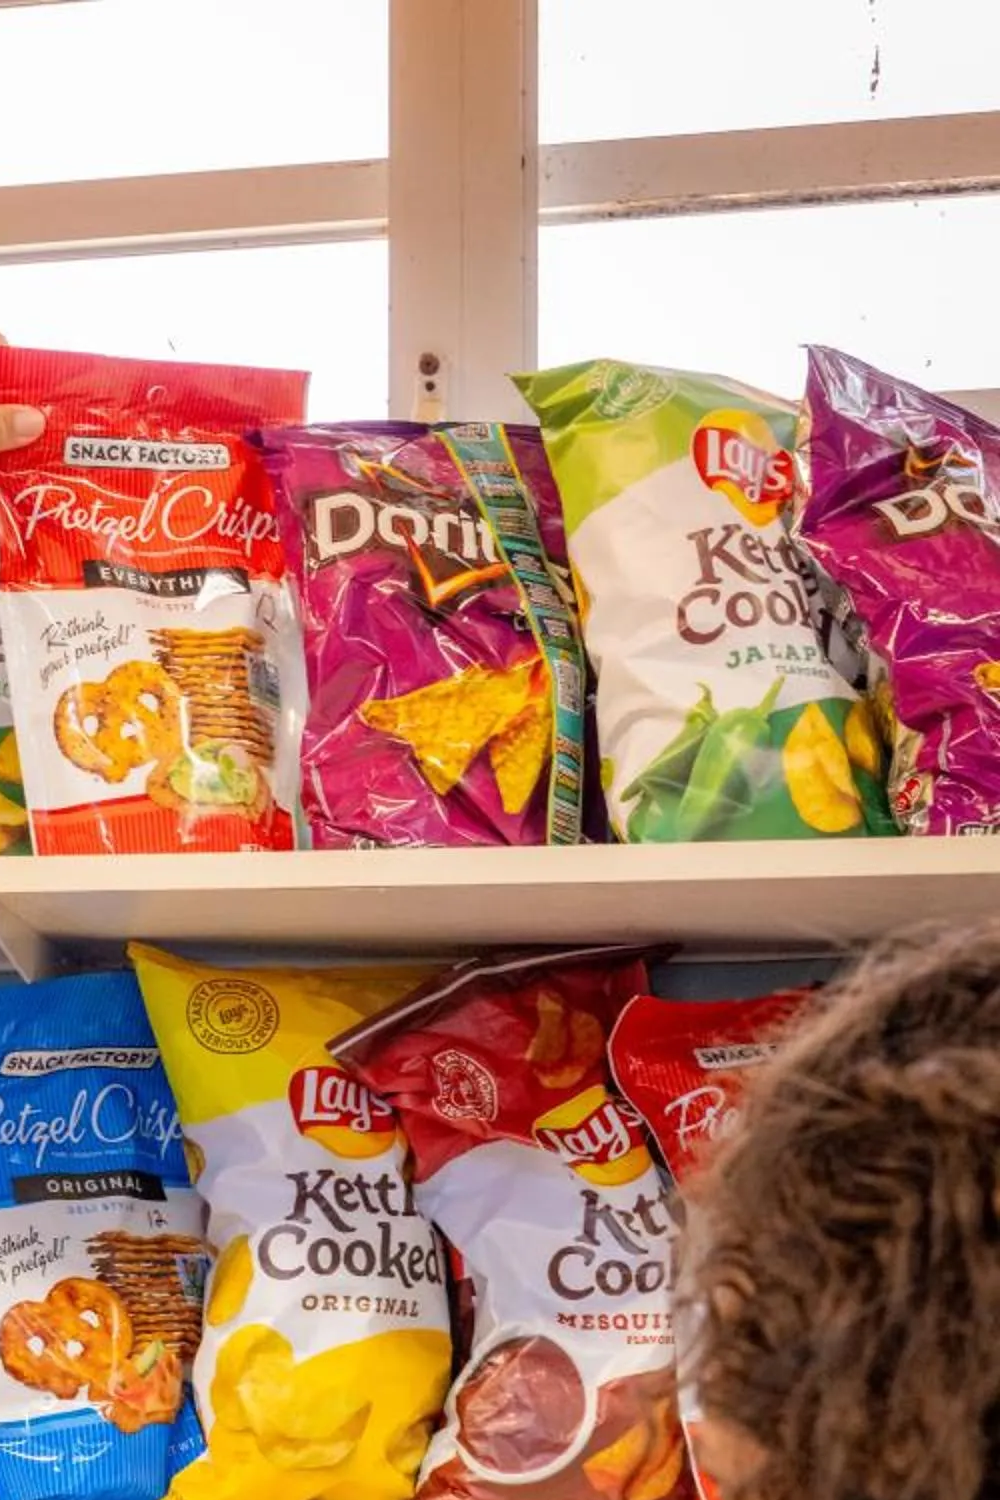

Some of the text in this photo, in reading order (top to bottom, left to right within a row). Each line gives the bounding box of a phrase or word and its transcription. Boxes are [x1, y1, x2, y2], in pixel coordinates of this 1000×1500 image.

[70, 443, 132, 461] SNACK
[14, 484, 158, 557] Pretzel
[314, 492, 499, 563] Dorit
[101, 566, 203, 591] EVERYTHI
[7, 1051, 149, 1071] SNACK FACTORY
[91, 1084, 183, 1160] Crisp
[47, 1175, 143, 1193] ORIGINAL
[286, 1169, 418, 1234] Kettl
[258, 1223, 442, 1289] Cooked
[301, 1295, 419, 1318] ORIGINAL
